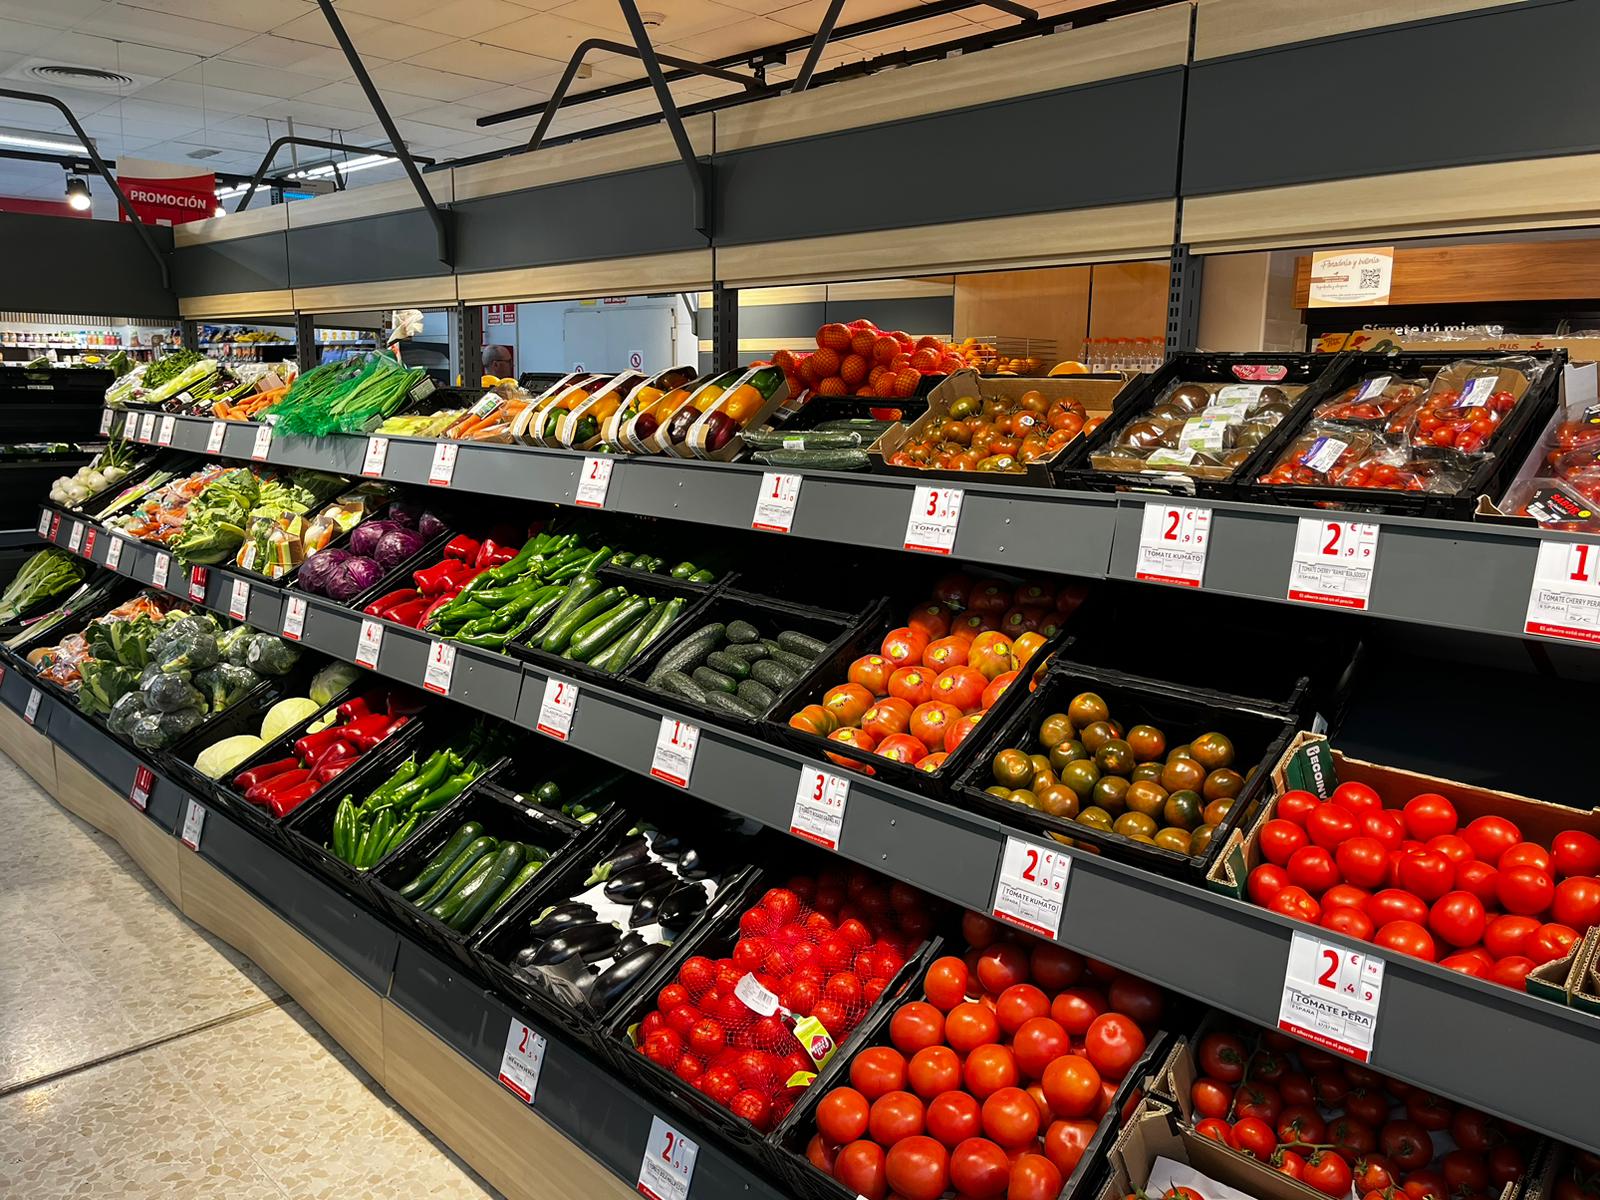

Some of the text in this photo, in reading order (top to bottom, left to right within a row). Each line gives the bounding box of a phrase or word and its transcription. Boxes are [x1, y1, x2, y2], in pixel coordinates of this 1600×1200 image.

[130, 190, 207, 209] PROMOCIÓN
[590, 460, 599, 480] 2
[771, 476, 781, 498] 1
[926, 491, 939, 516] 3
[1550, 493, 1581, 517] SABOR
[914, 524, 952, 534] TOMATE
[1164, 510, 1193, 541] 2 €
[1322, 522, 1358, 556] 2 €
[1147, 550, 1172, 559] TOMATE
[1172, 553, 1201, 562] KUMATO
[1569, 544, 1589, 582] 1
[1301, 565, 1317, 574] TOMATE
[1543, 594, 1565, 604] TOMATE
[1566, 597, 1587, 606] CHERRY
[436, 644, 443, 663] 3
[554, 682, 564, 705] 2
[671, 720, 681, 745] 1
[813, 774, 825, 801] 3
[1022, 849, 1039, 882] 2
[1045, 854, 1053, 864] €
[1005, 887, 1057, 912] TOMATE KUMATO
[1318, 949, 1377, 990] 2 € kg
[1291, 1003, 1316, 1017] ESPAÑA
[1295, 994, 1340, 1016] TOMATE
[1341, 1010, 1369, 1027] PERA
[518, 1027, 529, 1054] 2
[1290, 1026, 1297, 1034] El
[1296, 1029, 1314, 1041] ahorro
[1313, 1035, 1325, 1045] está
[1338, 1045, 1355, 1056] precio
[662, 1131, 674, 1163] 2
